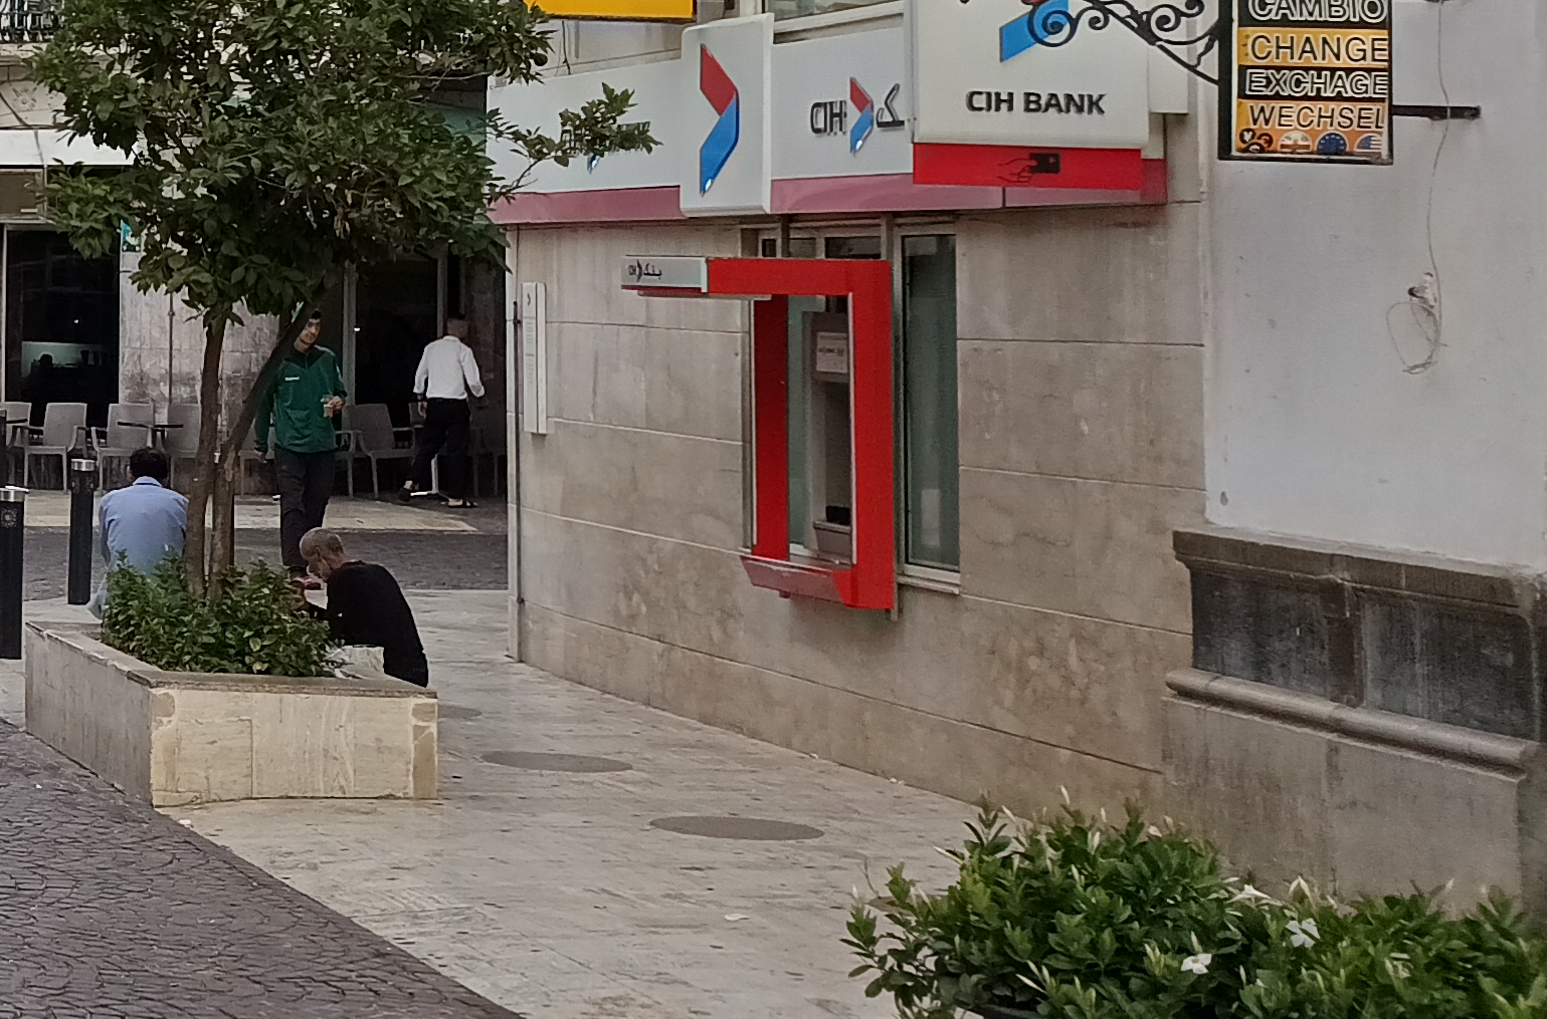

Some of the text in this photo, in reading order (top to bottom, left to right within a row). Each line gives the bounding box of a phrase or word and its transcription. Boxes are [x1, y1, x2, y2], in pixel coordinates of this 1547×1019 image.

[1251, 34, 1388, 63] CHANGE
[1246, 68, 1388, 98] EXCHAGE
[965, 90, 1107, 115] CIH BANK
[1249, 104, 1385, 130] WECHSEL
[810, 100, 847, 135] CIH
